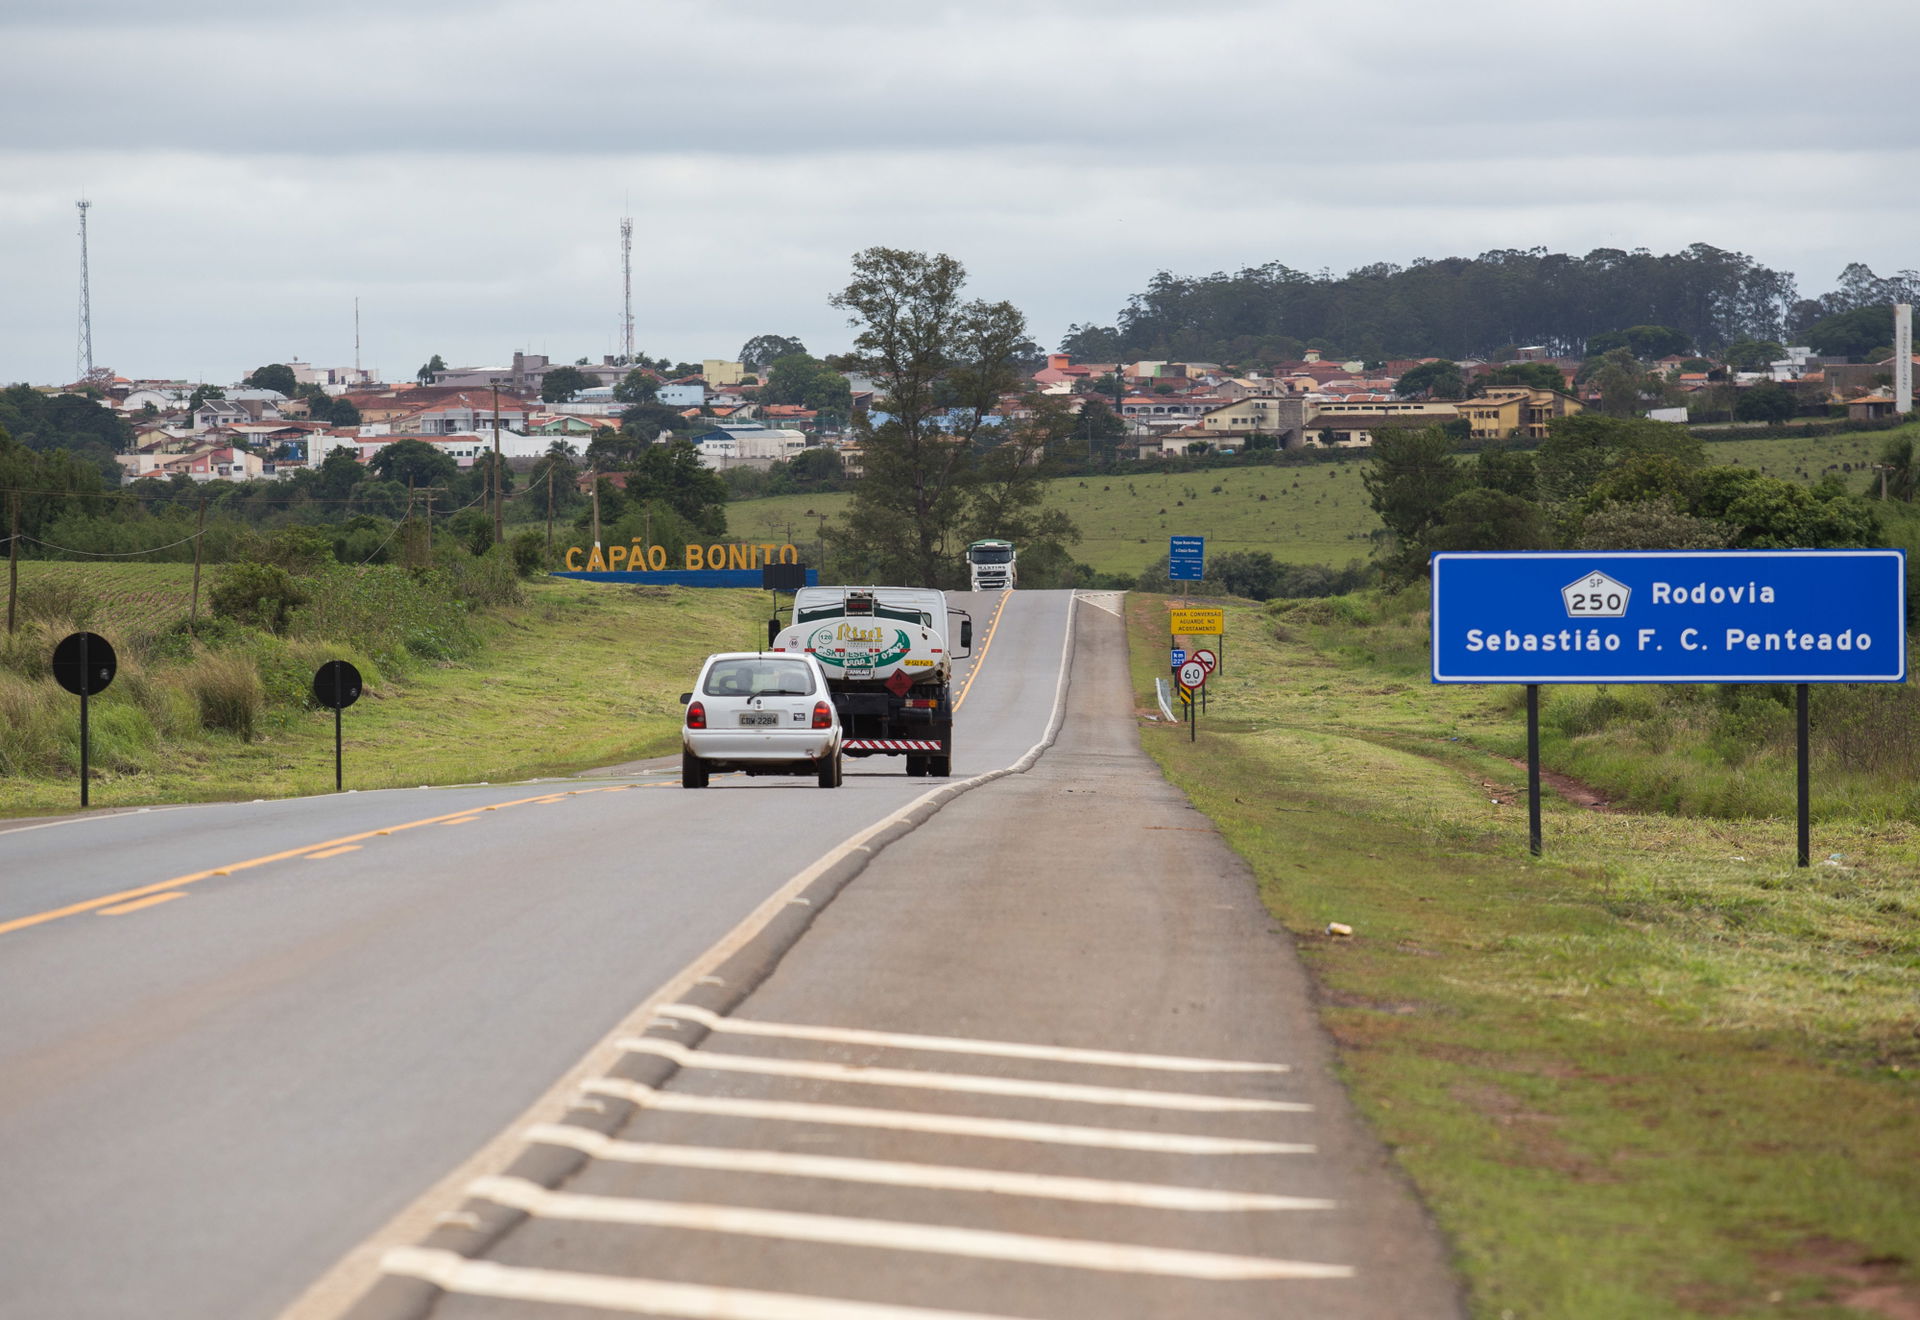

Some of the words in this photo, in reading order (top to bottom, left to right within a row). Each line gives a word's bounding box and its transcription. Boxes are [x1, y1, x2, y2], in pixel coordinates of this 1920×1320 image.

[565, 537, 667, 572] CAPÃO
[685, 544, 798, 570] BONITO
[1589, 578, 1604, 588] SP
[1652, 581, 1776, 604] Rodovia
[1572, 593, 1621, 610] 250
[1638, 629, 1662, 651] F.
[1680, 628, 1708, 651] C.
[1726, 628, 1872, 651] Penteado
[1184, 669, 1200, 679] 60
